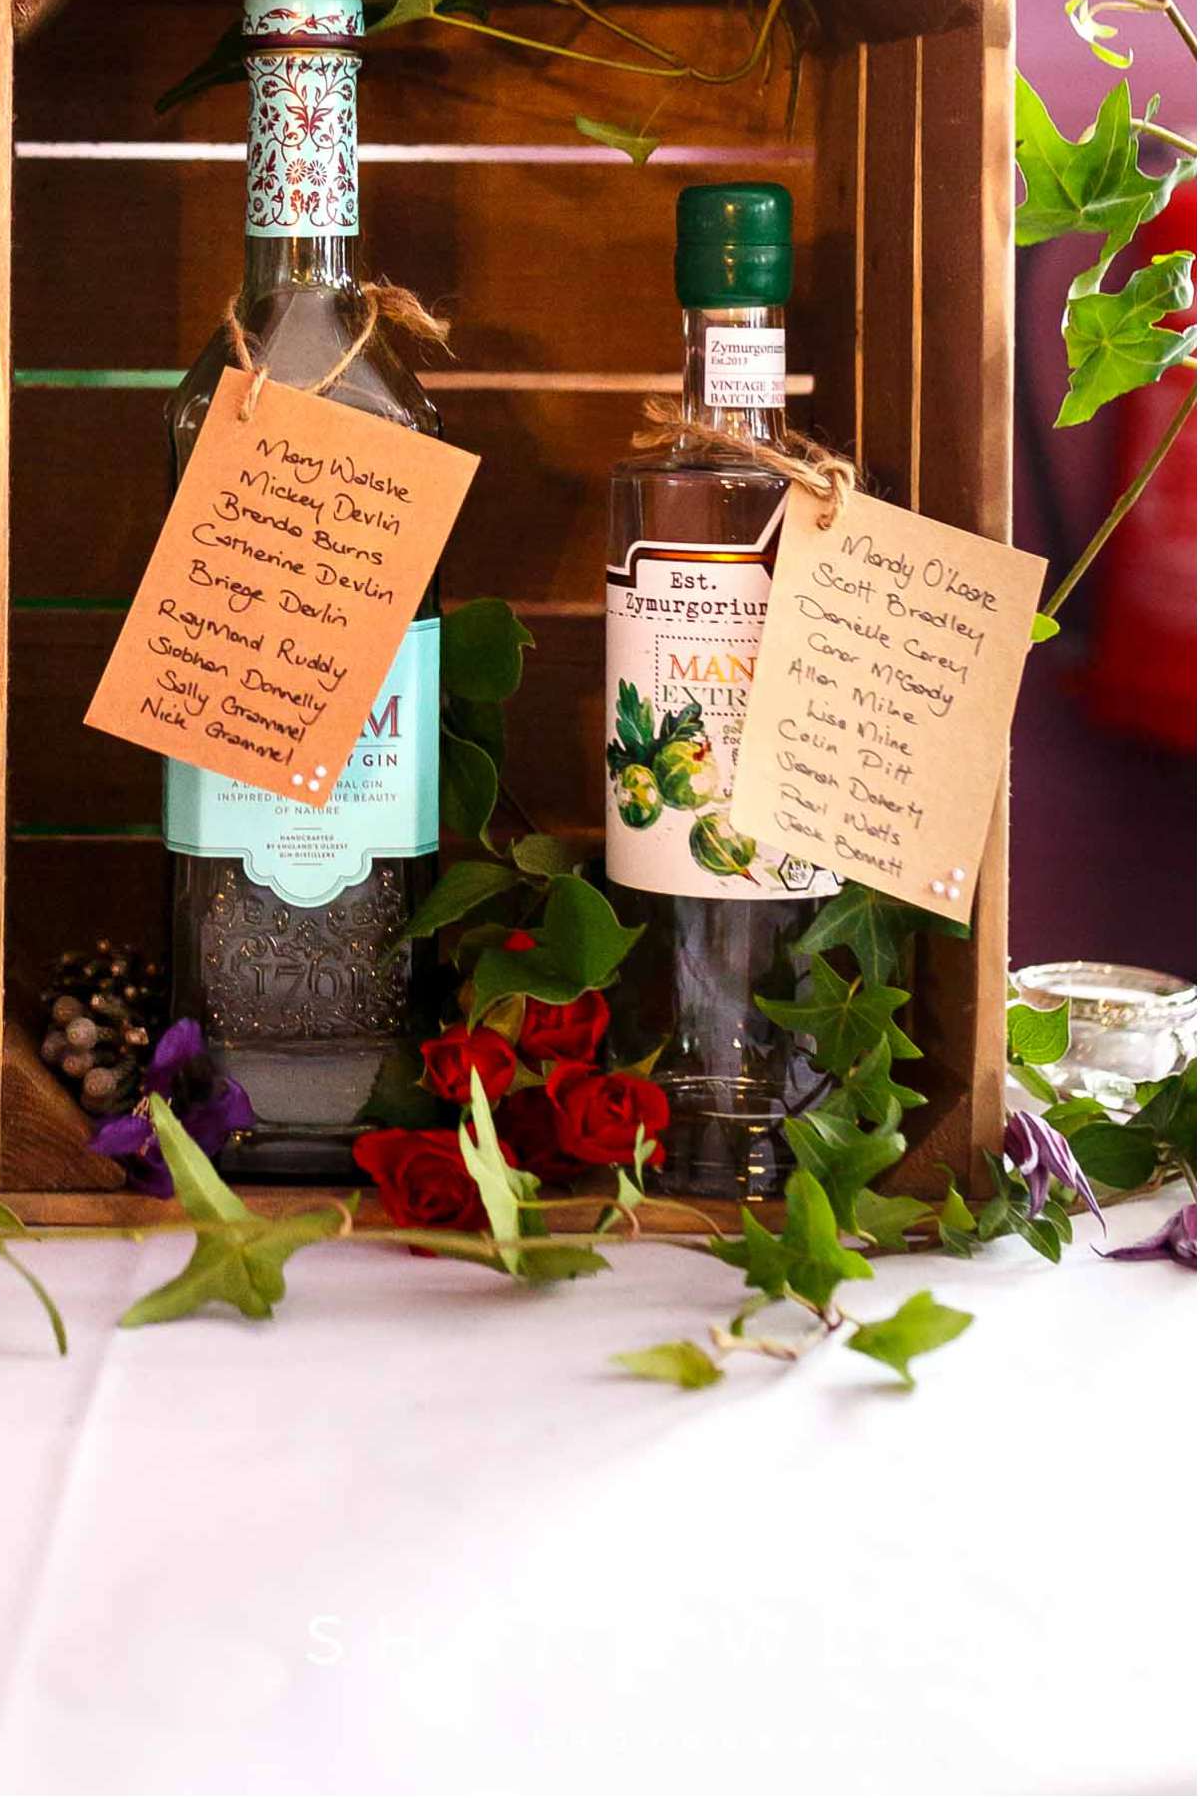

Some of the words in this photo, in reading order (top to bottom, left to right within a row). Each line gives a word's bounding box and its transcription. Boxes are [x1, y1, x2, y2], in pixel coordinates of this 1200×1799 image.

[710, 380, 768, 392] VINTAGE
[710, 393, 754, 404] BATCH
[256, 439, 323, 484] Mary
[330, 456, 411, 503] Walshe
[240, 470, 324, 525] Mickey
[333, 493, 400, 535] Devlin
[213, 491, 303, 537] Brenda
[312, 530, 382, 565] Burns
[192, 523, 306, 575] Catherine
[315, 563, 393, 604] Devlin
[669, 570, 718, 591] Est.
[841, 535, 914, 589] Mandy
[189, 559, 265, 613] Briege
[279, 589, 347, 627] Devlin
[812, 562, 876, 603] Scott
[886, 593, 984, 656] Bradley
[158, 599, 264, 652] Raymond
[277, 638, 347, 692] Ruddy
[148, 636, 228, 677] Siobhan
[240, 669, 327, 725] Donnelly
[157, 670, 209, 714] Sally
[140, 697, 200, 730] Nick
[362, 754, 399, 767] GIN
[777, 751, 839, 788] Sarah
[216, 792, 273, 803] INSPIRED
[353, 793, 398, 803] BEAUTY
[362, 780, 384, 789] GIN
[274, 806, 290, 815] OF
